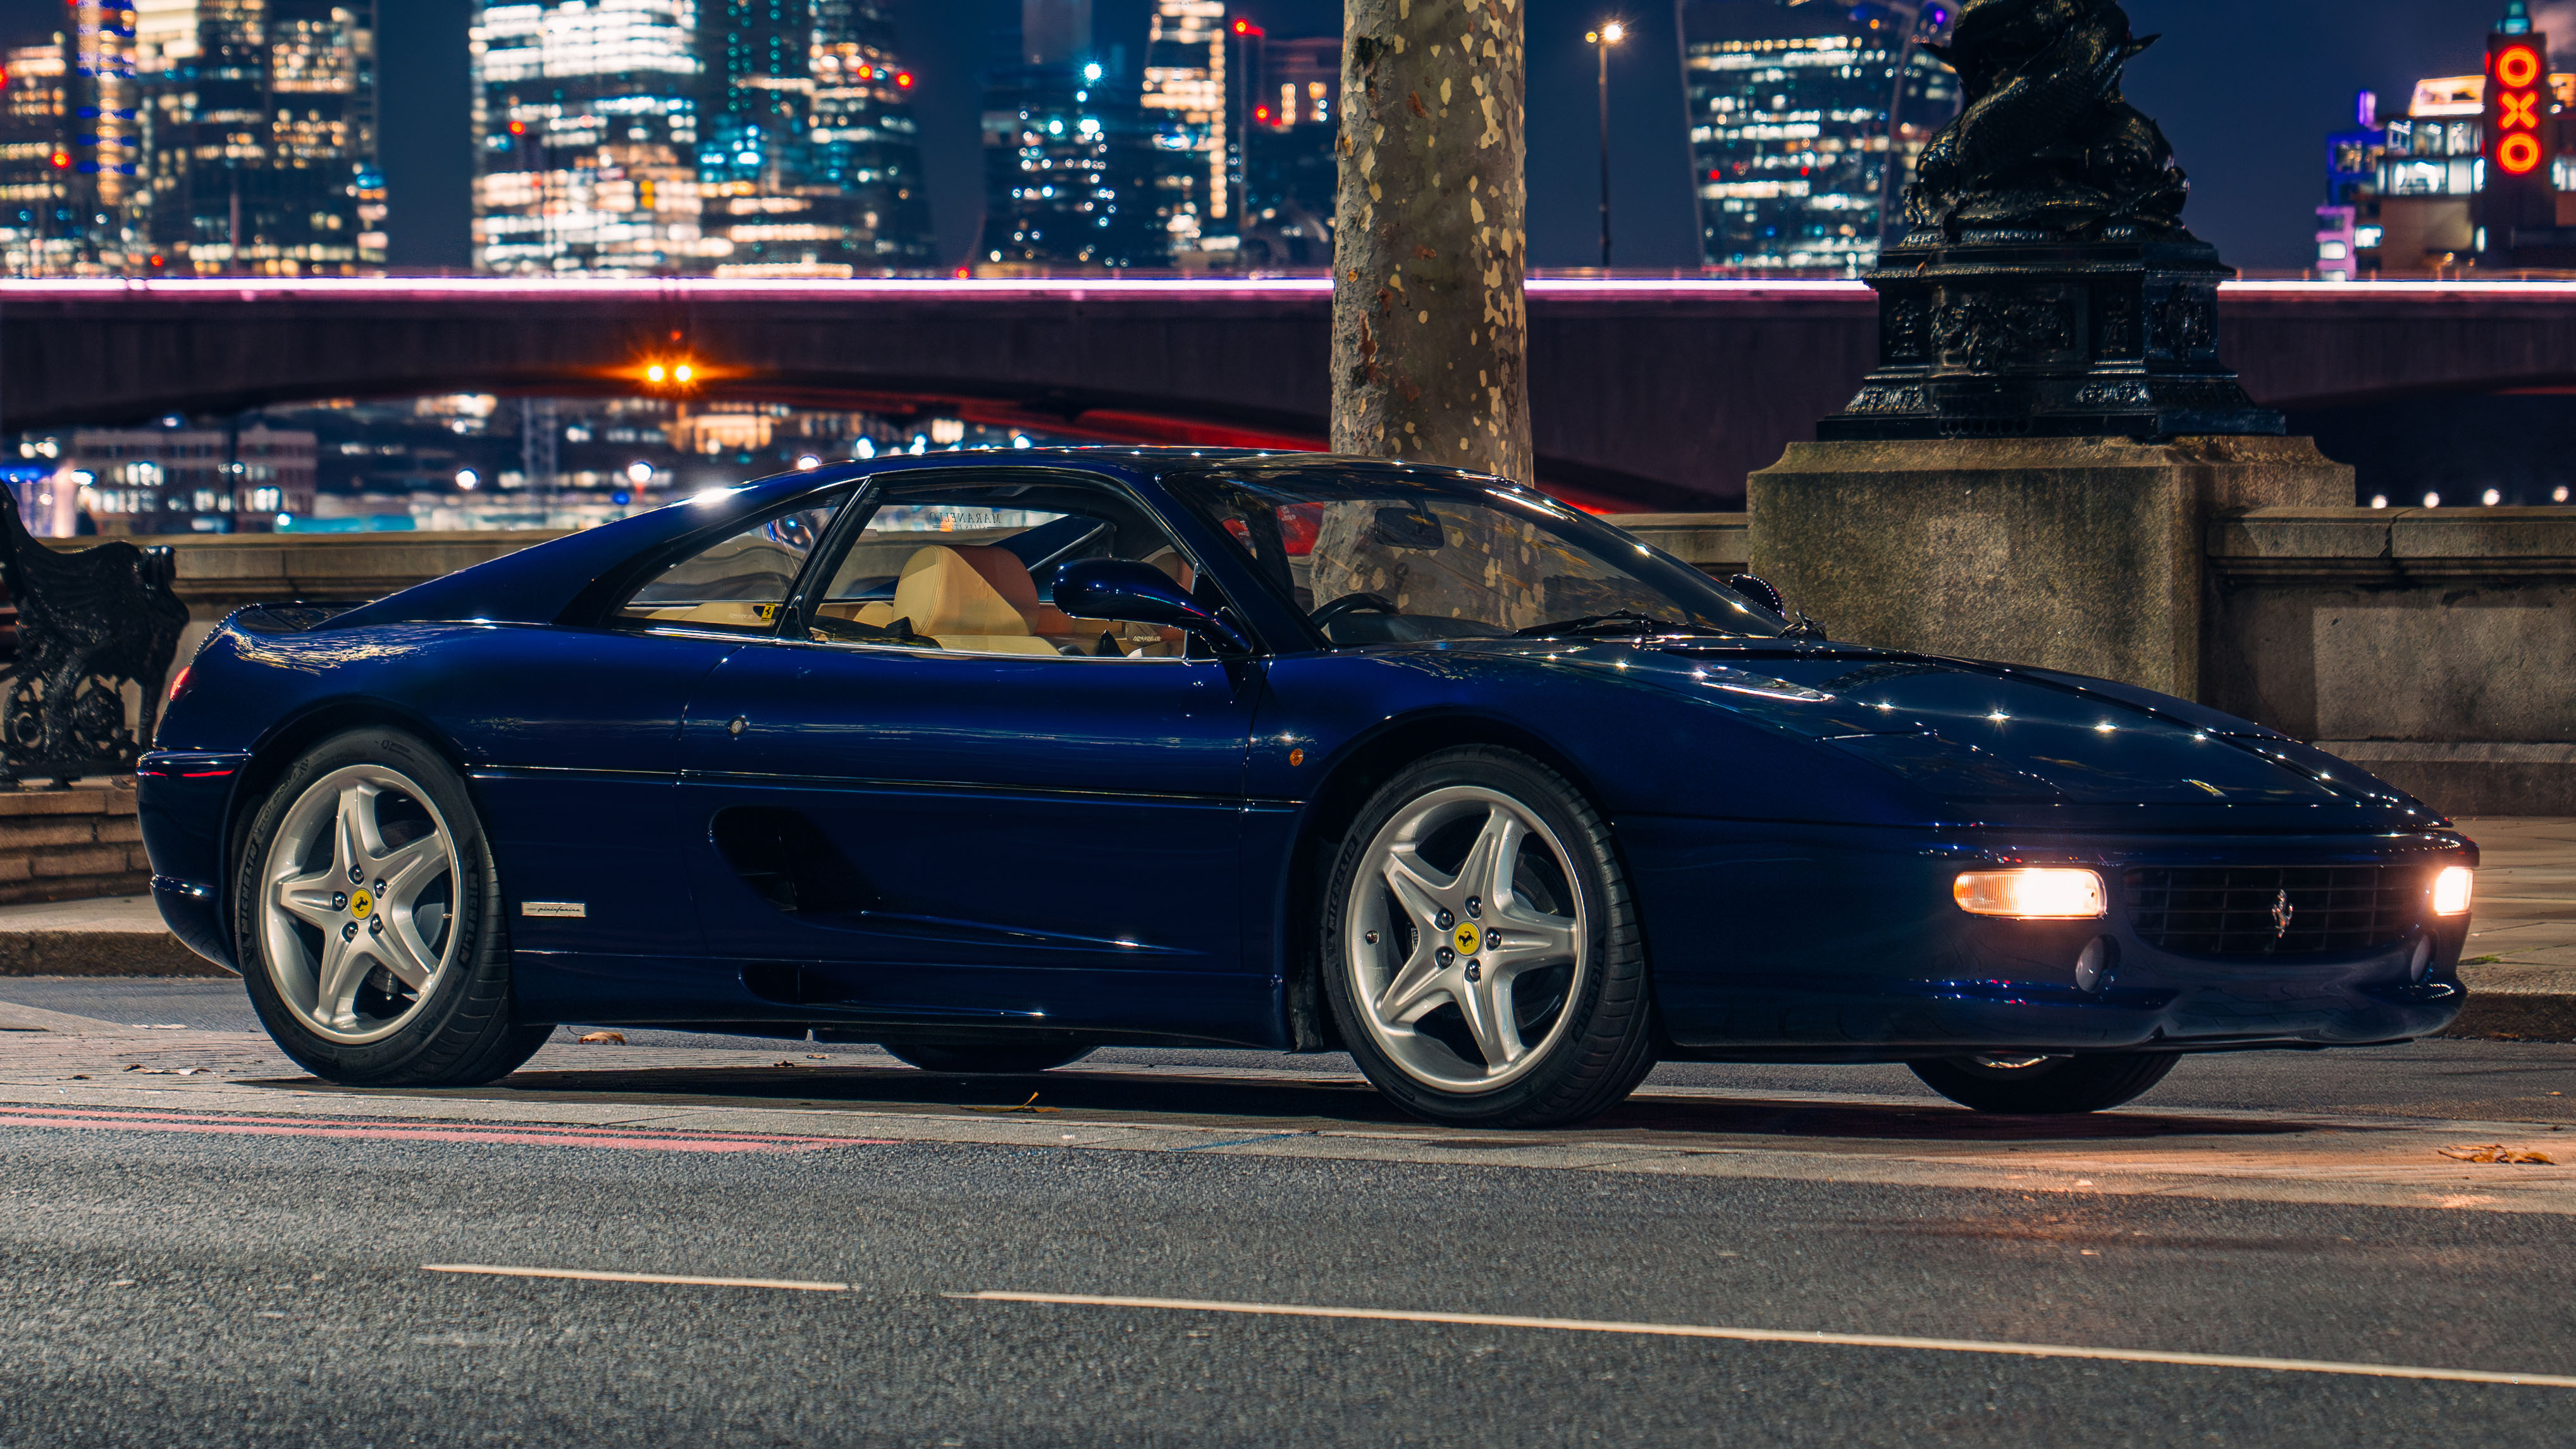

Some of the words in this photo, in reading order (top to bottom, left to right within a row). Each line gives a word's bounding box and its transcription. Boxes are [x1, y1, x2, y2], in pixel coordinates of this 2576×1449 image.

[2495, 44, 2542, 176] OXO
[241, 839, 258, 934] MICHELIN
[1329, 839, 1355, 930] MICHELIN
